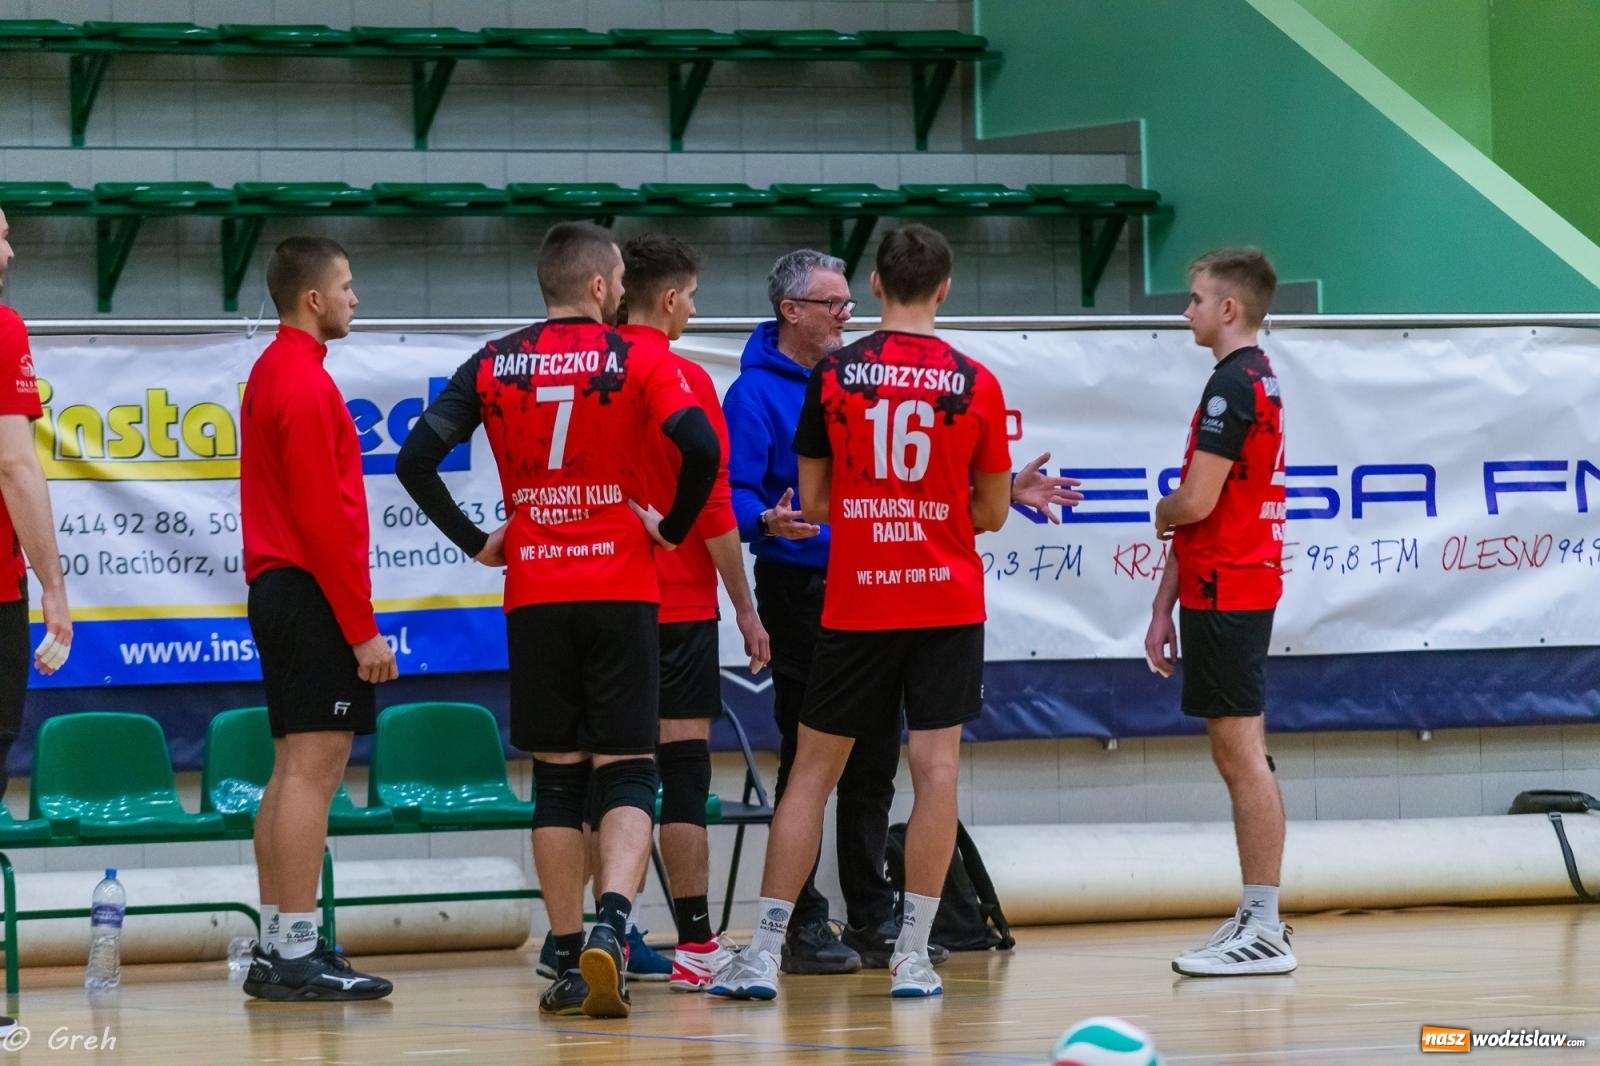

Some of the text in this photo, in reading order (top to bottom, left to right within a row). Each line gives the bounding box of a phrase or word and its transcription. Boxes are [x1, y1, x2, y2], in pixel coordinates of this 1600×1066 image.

[493, 350, 624, 377] BARTECZKO A.
[843, 363, 965, 395] SKORZYSKO
[35, 378, 247, 459] insta
[536, 385, 575, 470] 7
[865, 399, 935, 482] 16
[586, 484, 622, 505] KLUB
[59, 511, 243, 537] 414 92 88, 50
[99, 550, 215, 577] Racibórz,
[520, 541, 615, 561] WE PLAY FOR FUN
[1029, 543, 1083, 581] FM
[1113, 543, 1169, 581] KRA
[1307, 544, 1360, 575] 95,8
[1371, 538, 1419, 574] FM
[1442, 534, 1552, 572] OLESNO
[857, 566, 951, 584] WE PLAY FOR FUN
